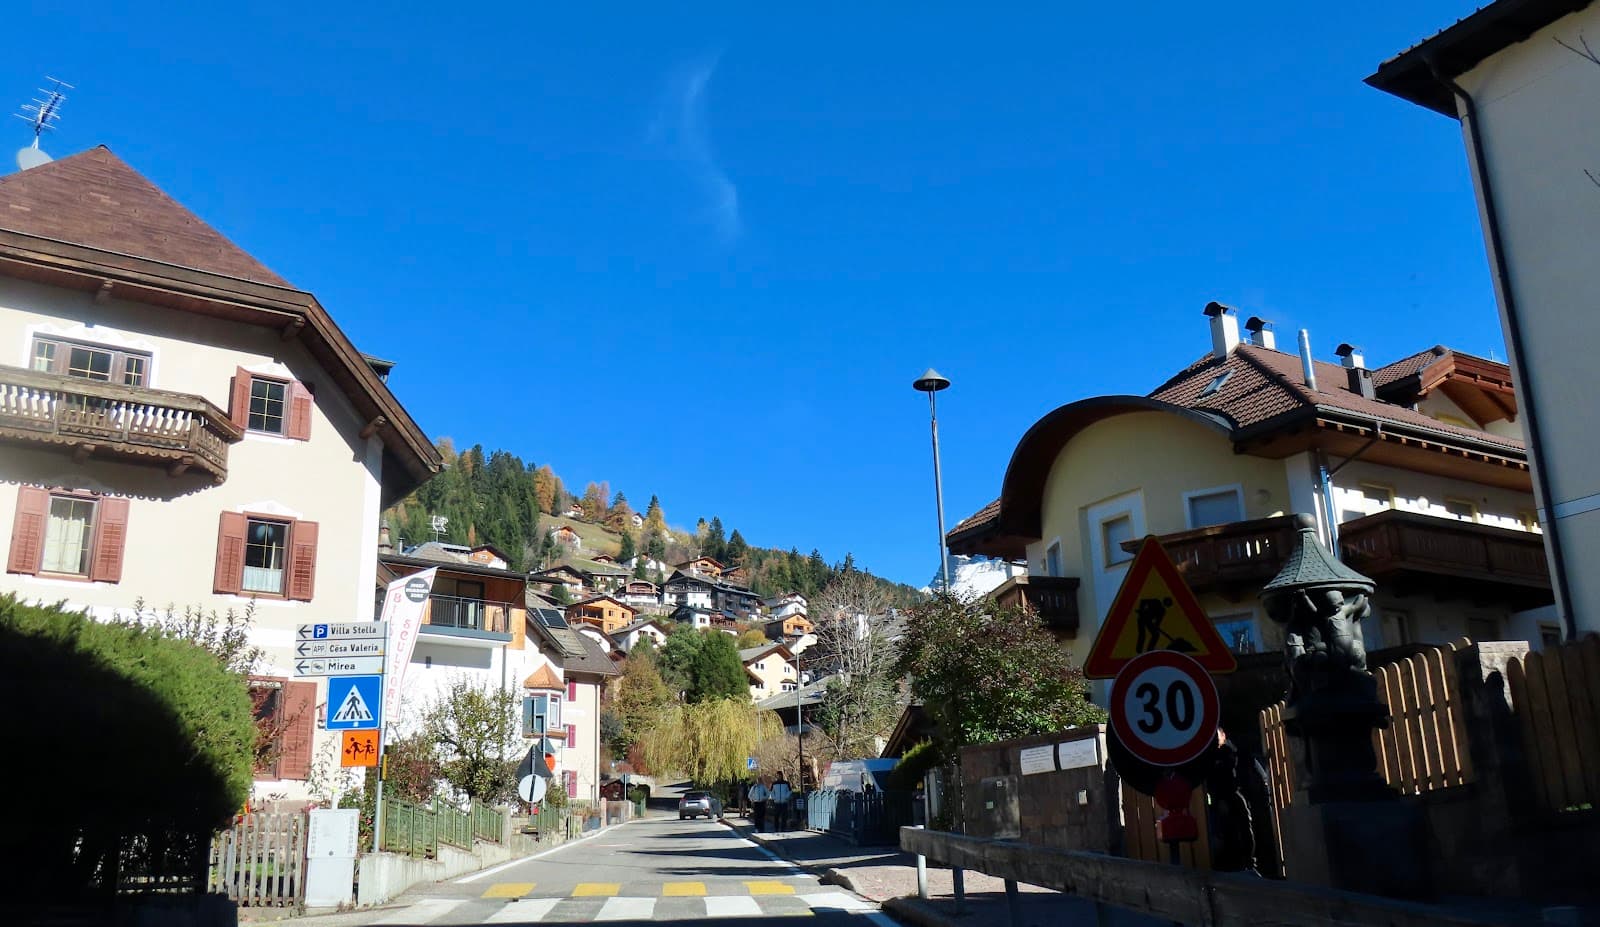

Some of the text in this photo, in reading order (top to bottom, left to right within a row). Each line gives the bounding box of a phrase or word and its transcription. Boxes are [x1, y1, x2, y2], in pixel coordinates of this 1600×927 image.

[316, 624, 377, 638] P Villa Stella
[350, 643, 378, 652] Valeria
[328, 662, 355, 670] Mirea
[1136, 680, 1195, 734] 30
